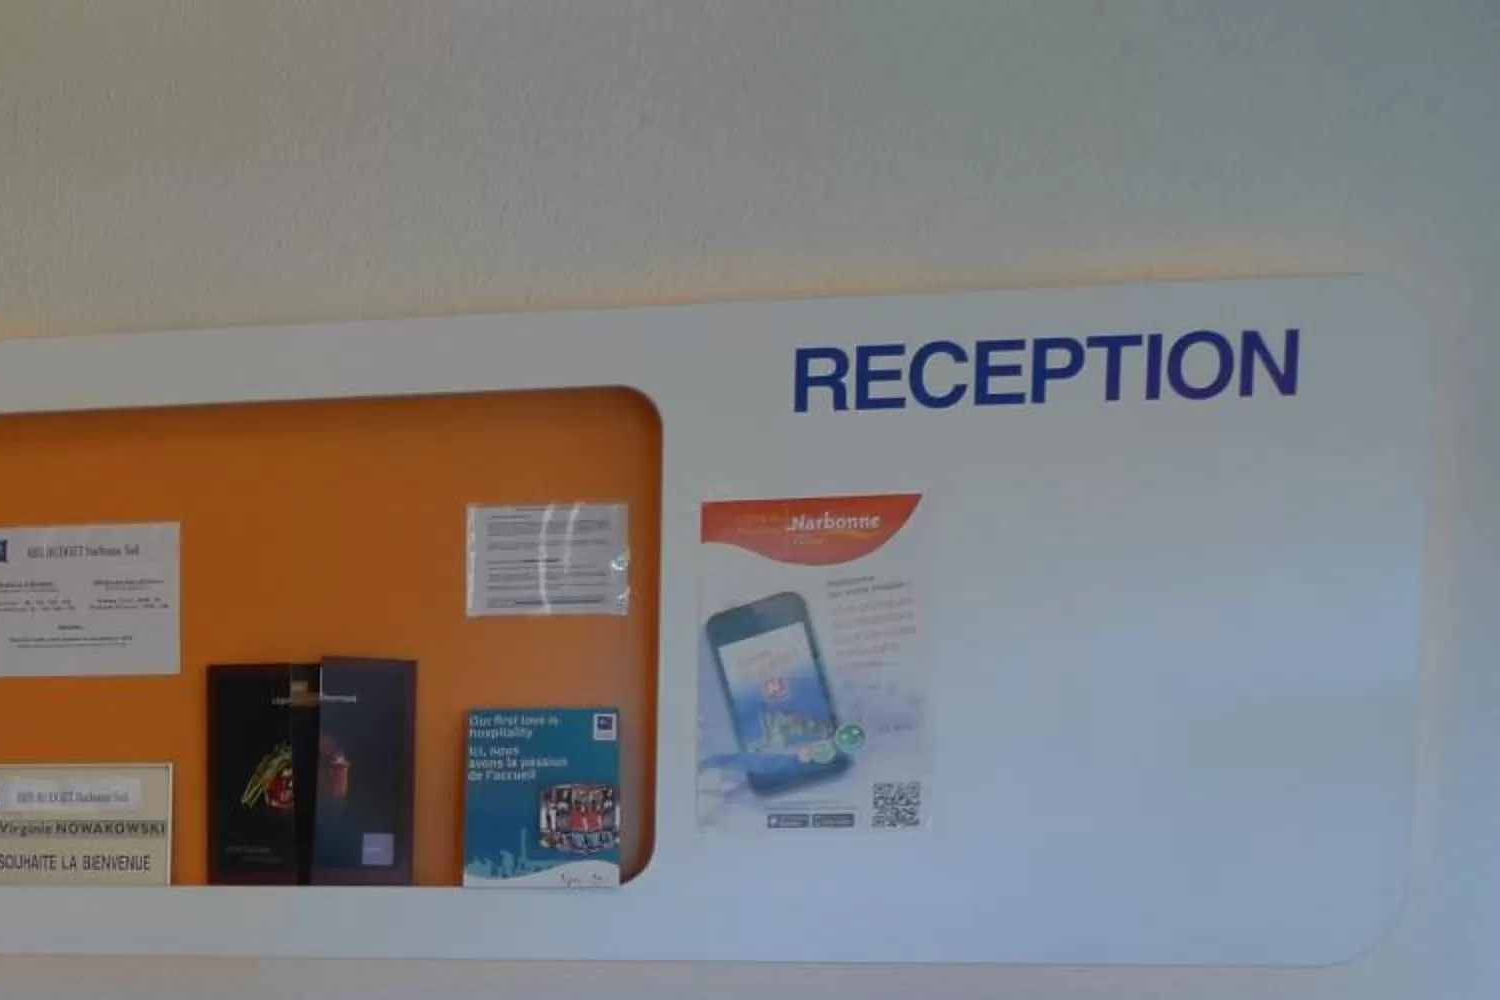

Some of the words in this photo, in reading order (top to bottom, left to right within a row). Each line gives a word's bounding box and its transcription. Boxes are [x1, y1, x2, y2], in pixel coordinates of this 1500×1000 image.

[792, 328, 1300, 413] RECEPTION
[791, 511, 881, 531] Narbonne
[0, 820, 52, 837] Virginie
[54, 821, 167, 836] NOWAKOWSKI
[61, 855, 77, 870] LA
[82, 854, 152, 871] BIENVENUE
